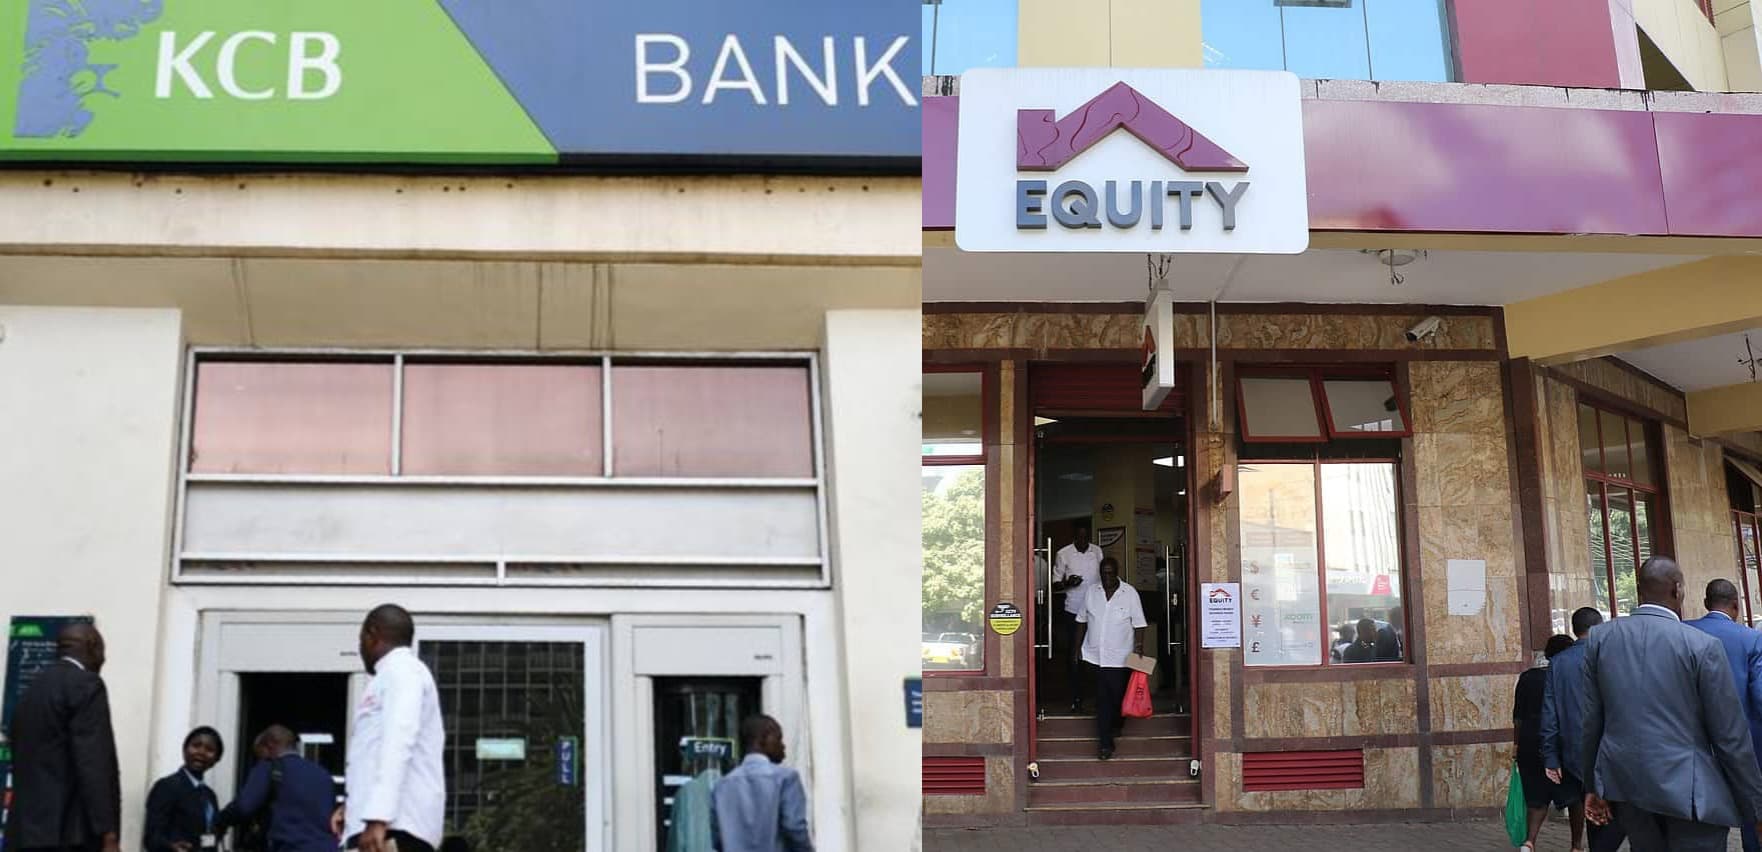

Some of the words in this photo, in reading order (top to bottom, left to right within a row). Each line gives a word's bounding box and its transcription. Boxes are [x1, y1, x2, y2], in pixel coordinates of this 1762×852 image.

[153, 29, 343, 101] KCB
[635, 33, 918, 106] BANK
[1016, 180, 1251, 231] EQUITY
[693, 741, 727, 756] Entry
